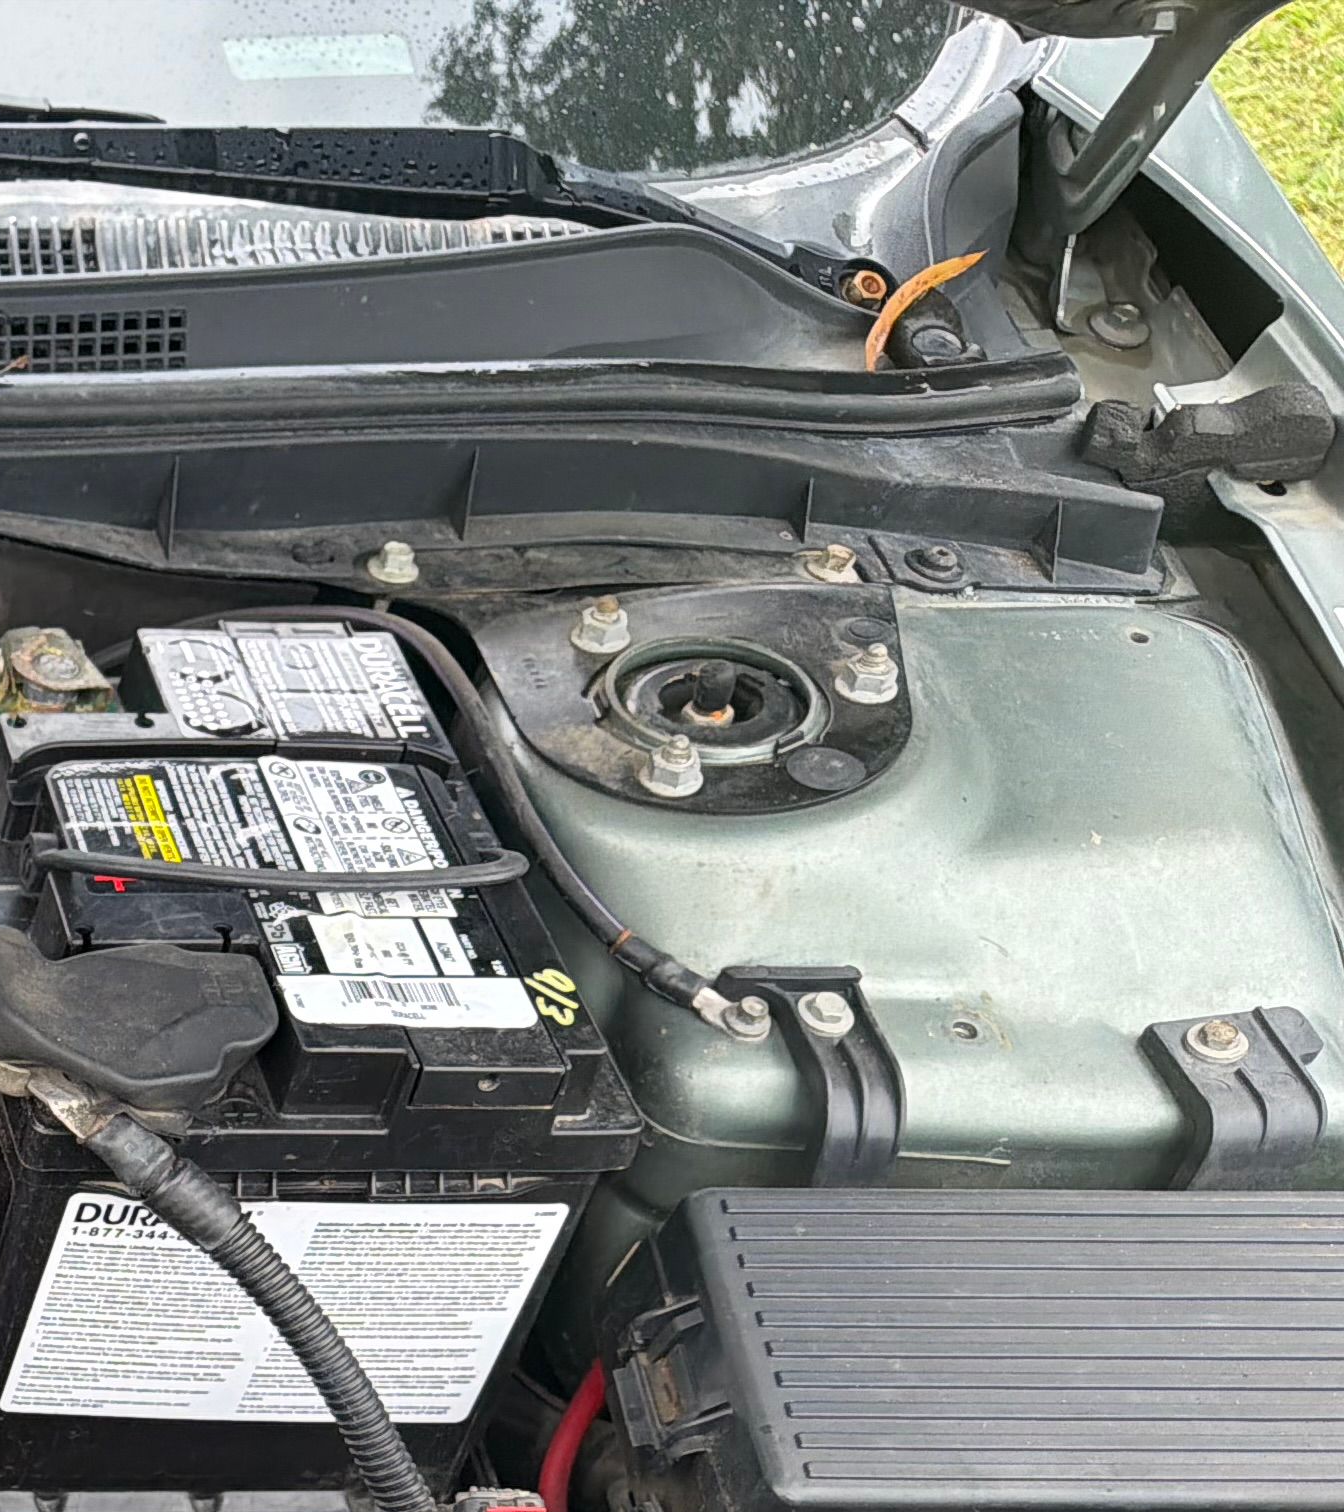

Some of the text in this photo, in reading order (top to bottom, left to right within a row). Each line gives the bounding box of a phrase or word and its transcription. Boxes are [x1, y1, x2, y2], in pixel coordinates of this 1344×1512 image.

[352, 637, 427, 739] DURACELL
[404, 799, 463, 898] DANGER/PON
[279, 948, 306, 972] AGM
[523, 968, 579, 1026] 9/3
